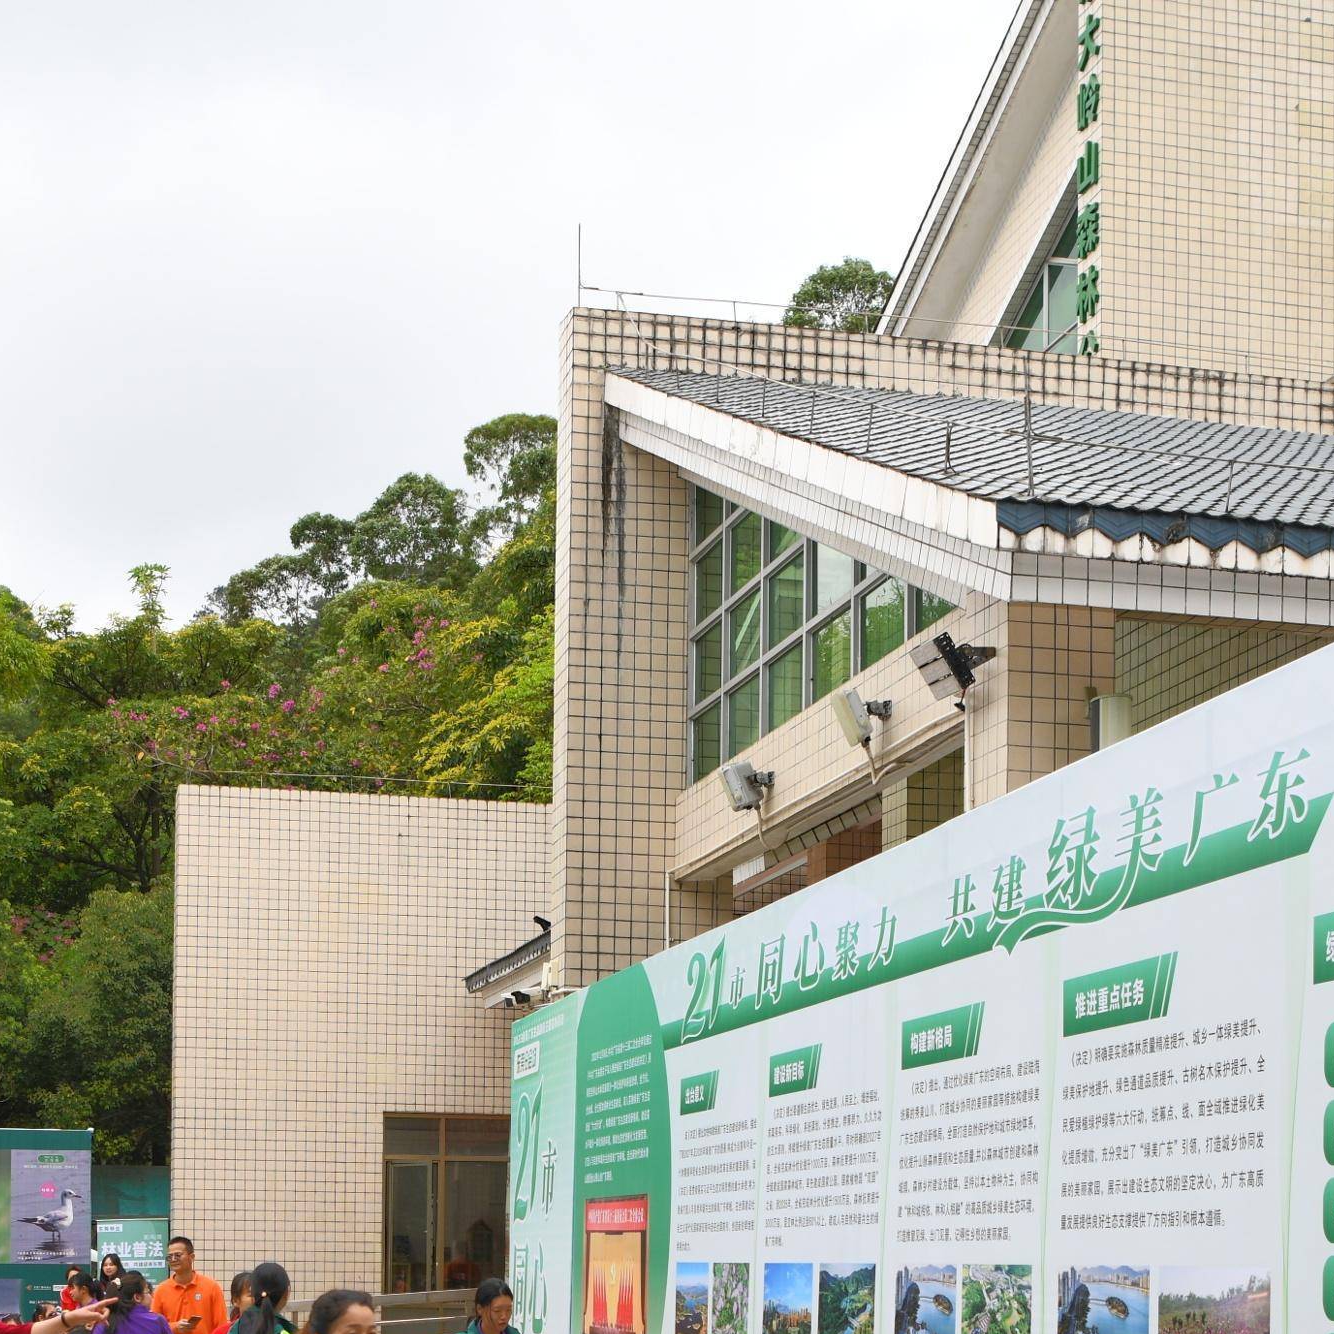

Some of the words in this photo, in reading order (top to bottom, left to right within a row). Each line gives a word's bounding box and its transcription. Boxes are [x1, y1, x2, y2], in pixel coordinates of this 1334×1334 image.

[1075, 979, 1145, 1020] 推进重点任务
[910, 1025, 953, 1056] 构建新格局
[774, 1061, 805, 1085] 建设新目标
[101, 1241, 164, 1258] 林业普法
